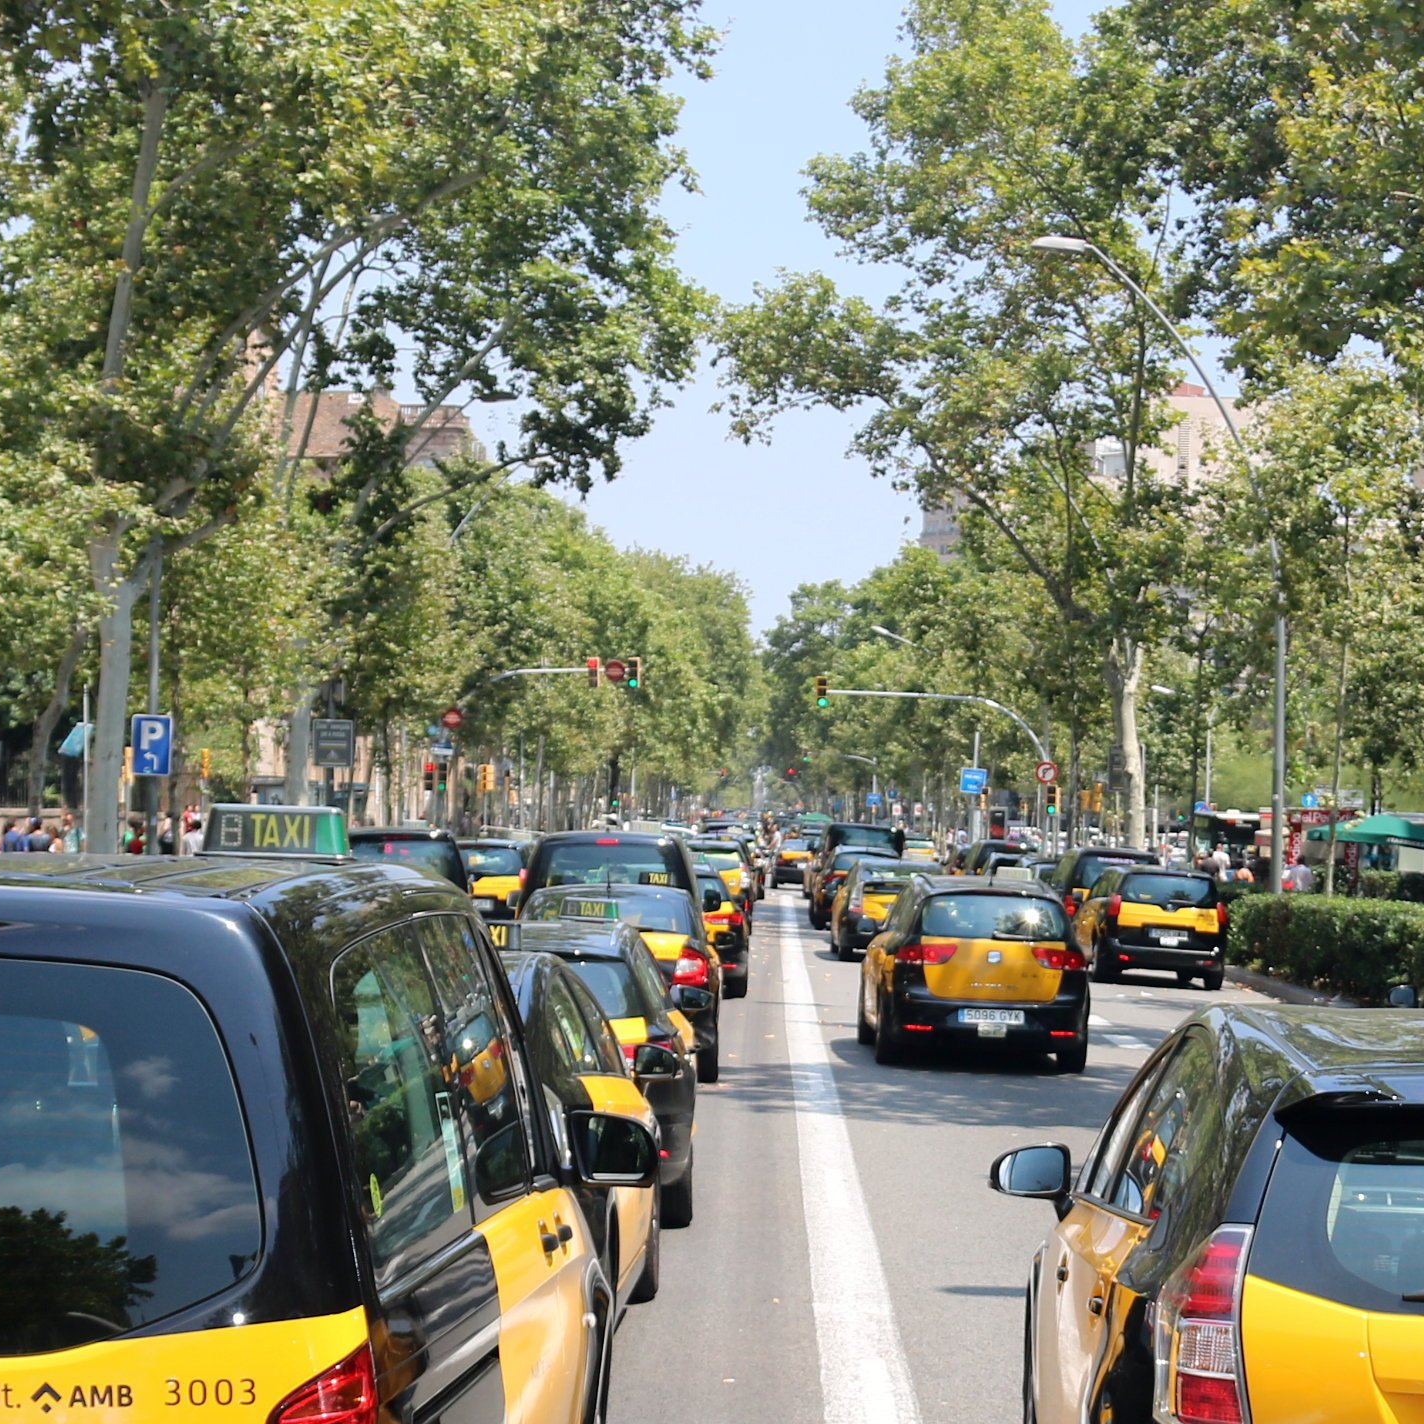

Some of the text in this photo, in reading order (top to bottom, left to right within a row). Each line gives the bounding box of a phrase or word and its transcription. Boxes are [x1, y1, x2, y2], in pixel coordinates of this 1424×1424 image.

[140, 720, 164, 750] P
[250, 813, 311, 849] TAXI
[648, 872, 669, 885] TAXI
[579, 901, 605, 917] TAXI
[490, 925, 507, 947] XI
[966, 1010, 1022, 1022] 5096 GYK
[68, 1385, 134, 1408] AMB
[164, 1378, 257, 1406] 3003
